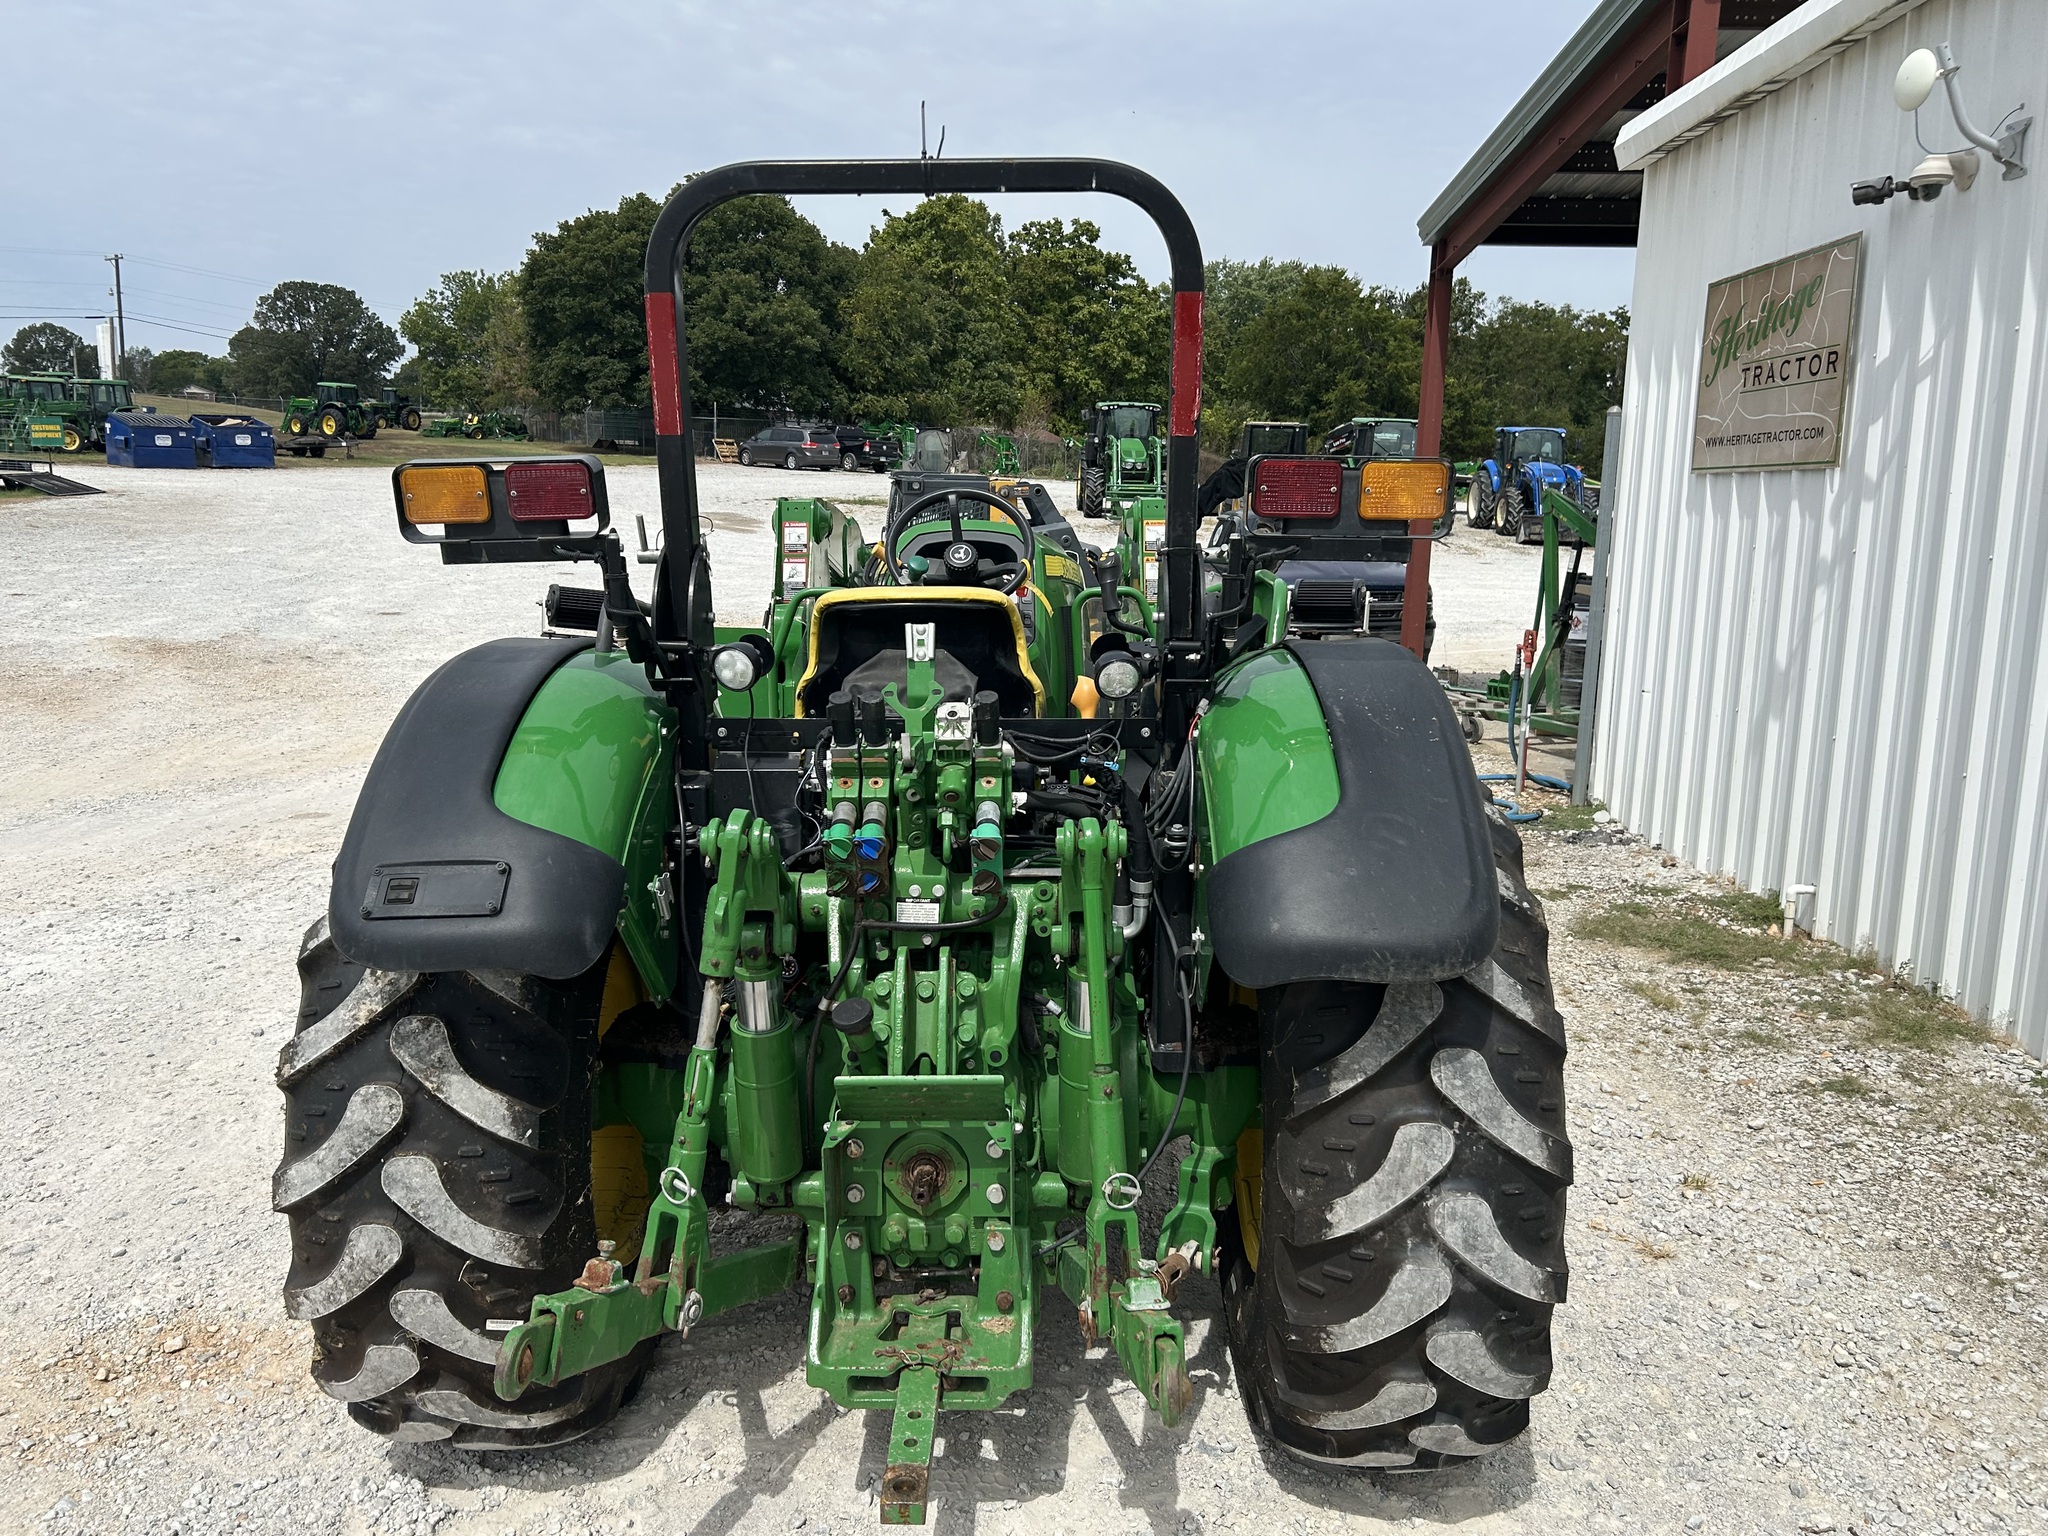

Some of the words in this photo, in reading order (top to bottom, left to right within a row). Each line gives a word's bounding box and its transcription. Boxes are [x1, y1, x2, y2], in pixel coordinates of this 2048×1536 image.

[1705, 275, 1823, 388] Heritage
[1741, 350, 1839, 388] TRACTOR
[1705, 427, 1824, 448] WWW.HERITAGETRACTOR.COM
